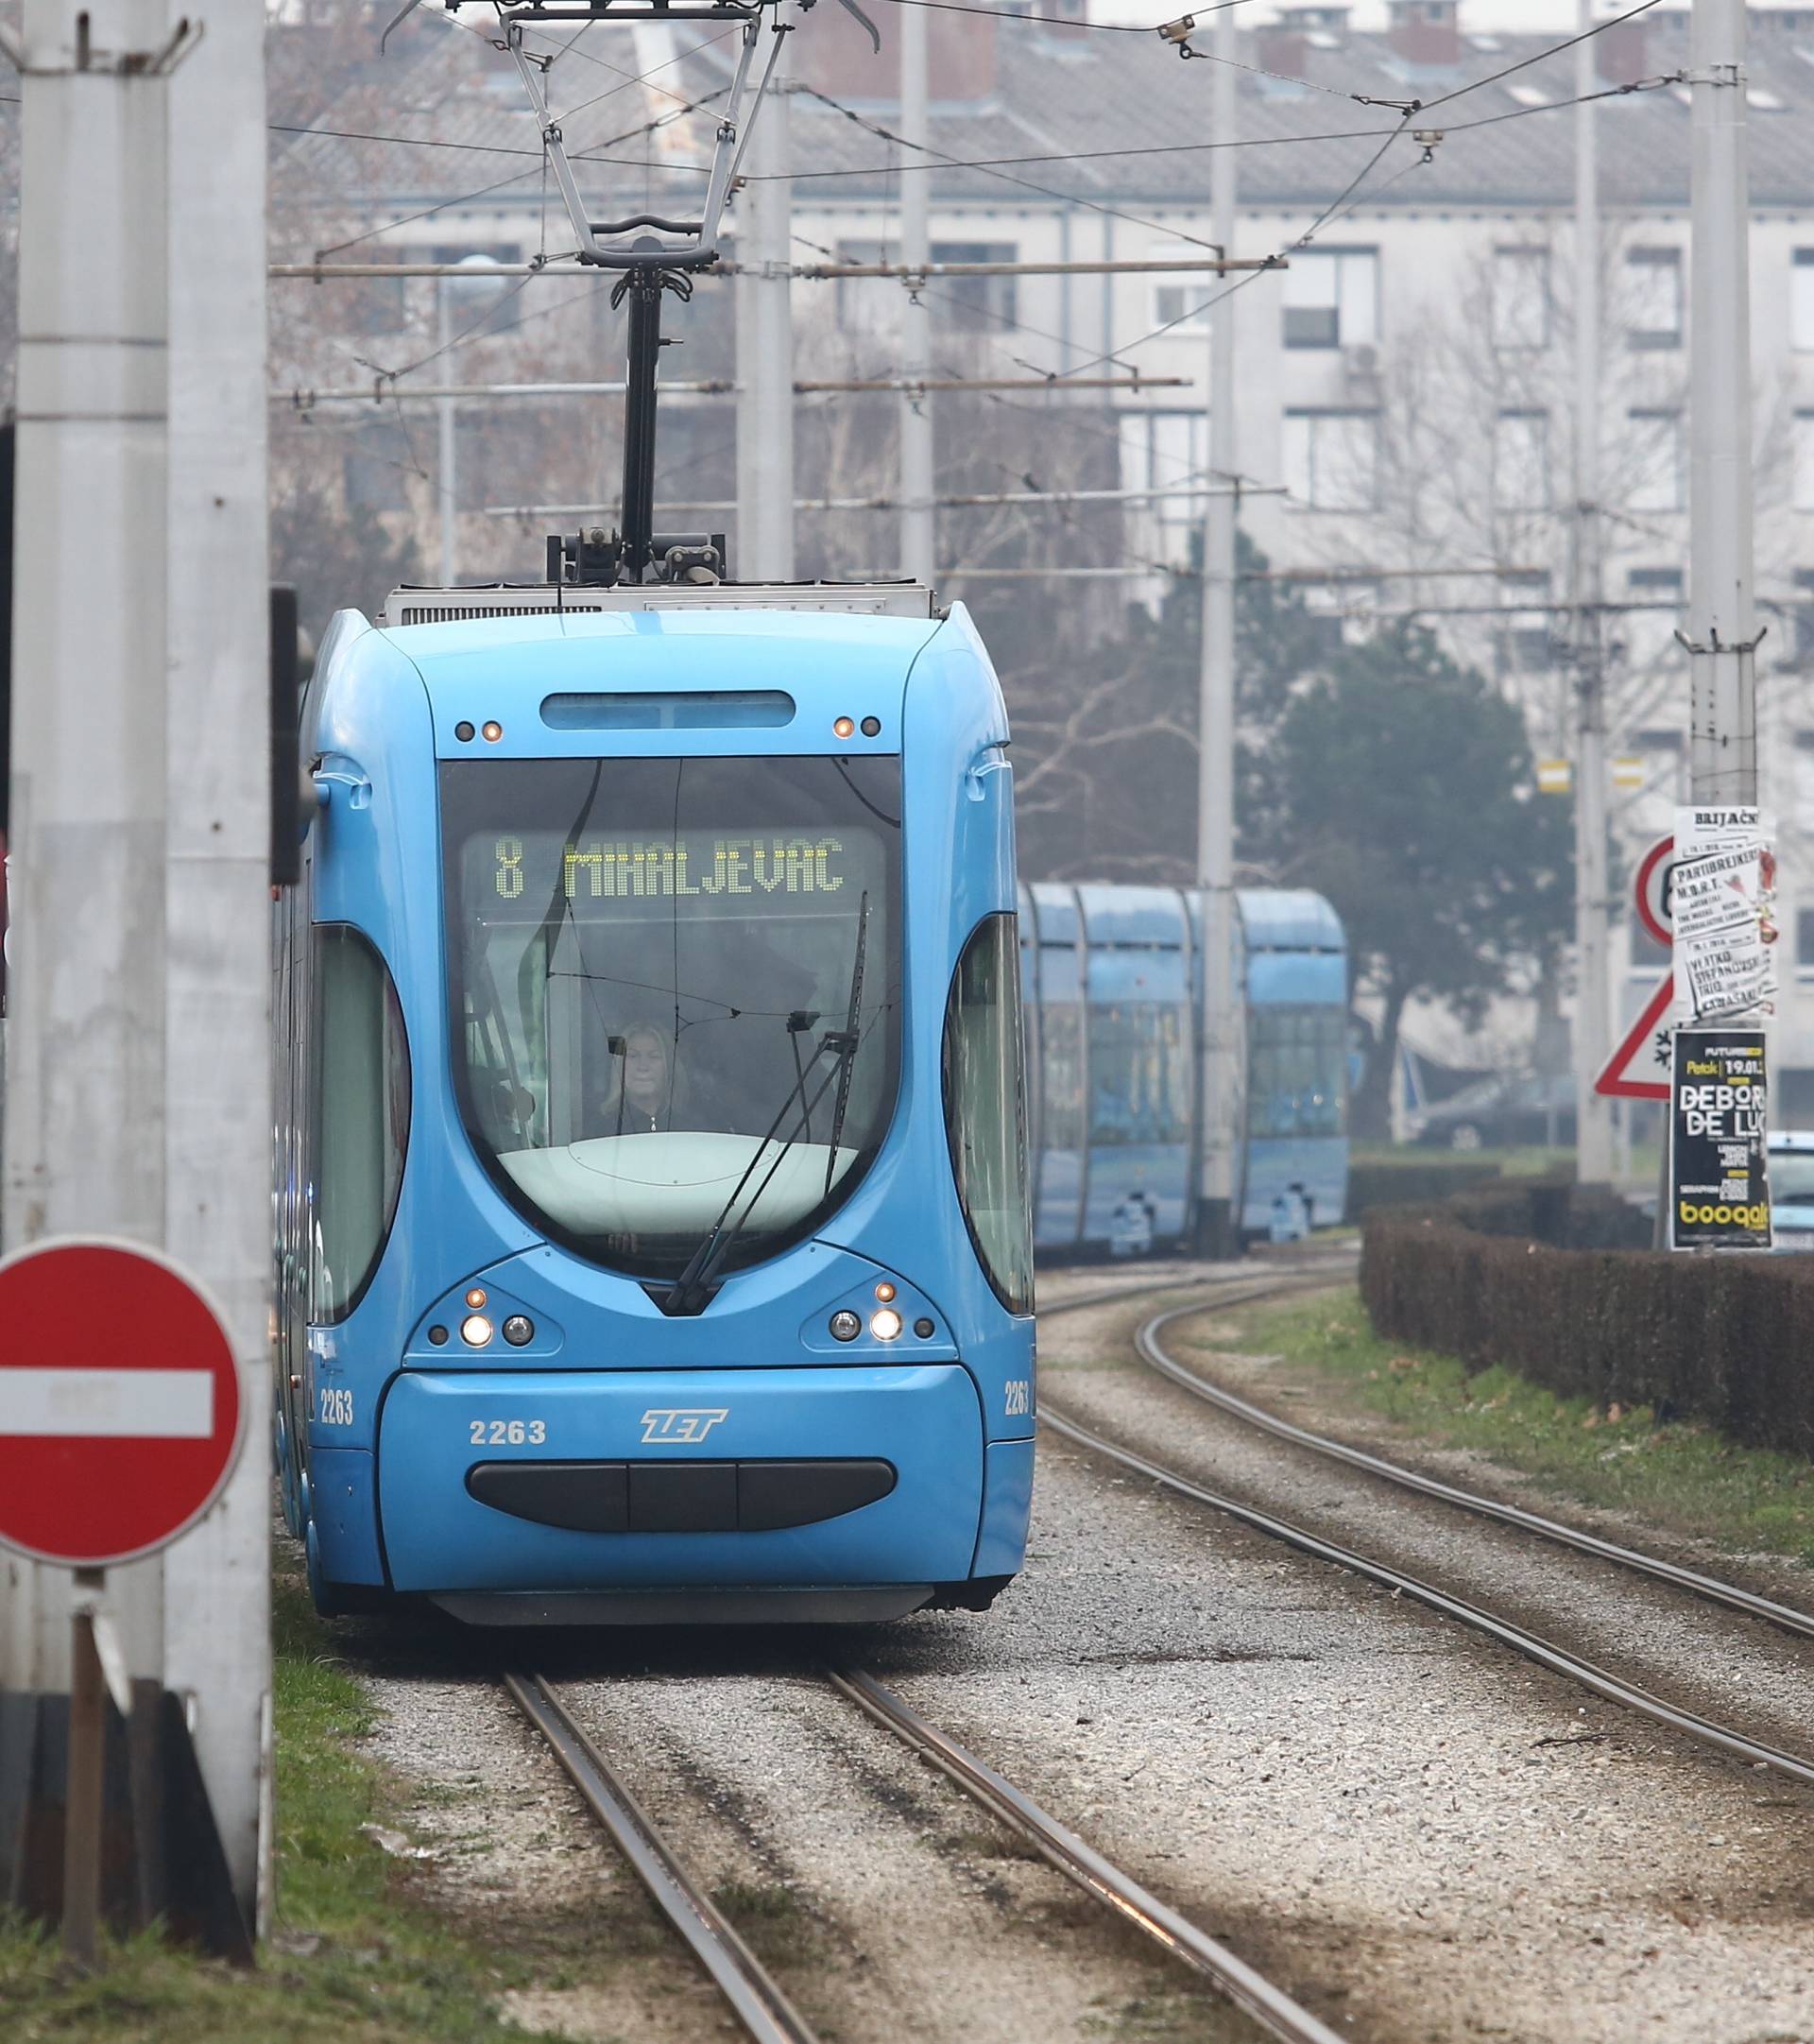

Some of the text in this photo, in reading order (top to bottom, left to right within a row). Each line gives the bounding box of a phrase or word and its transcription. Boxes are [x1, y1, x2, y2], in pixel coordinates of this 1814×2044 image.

[495, 835, 844, 898] 8 MIHALJEVAC
[1686, 1110, 1723, 1136] DE
[321, 1388, 353, 1425] 2263
[1004, 1381, 1029, 1416] 2263
[470, 1420, 546, 1445] 2263
[640, 1408, 728, 1443] ZET
